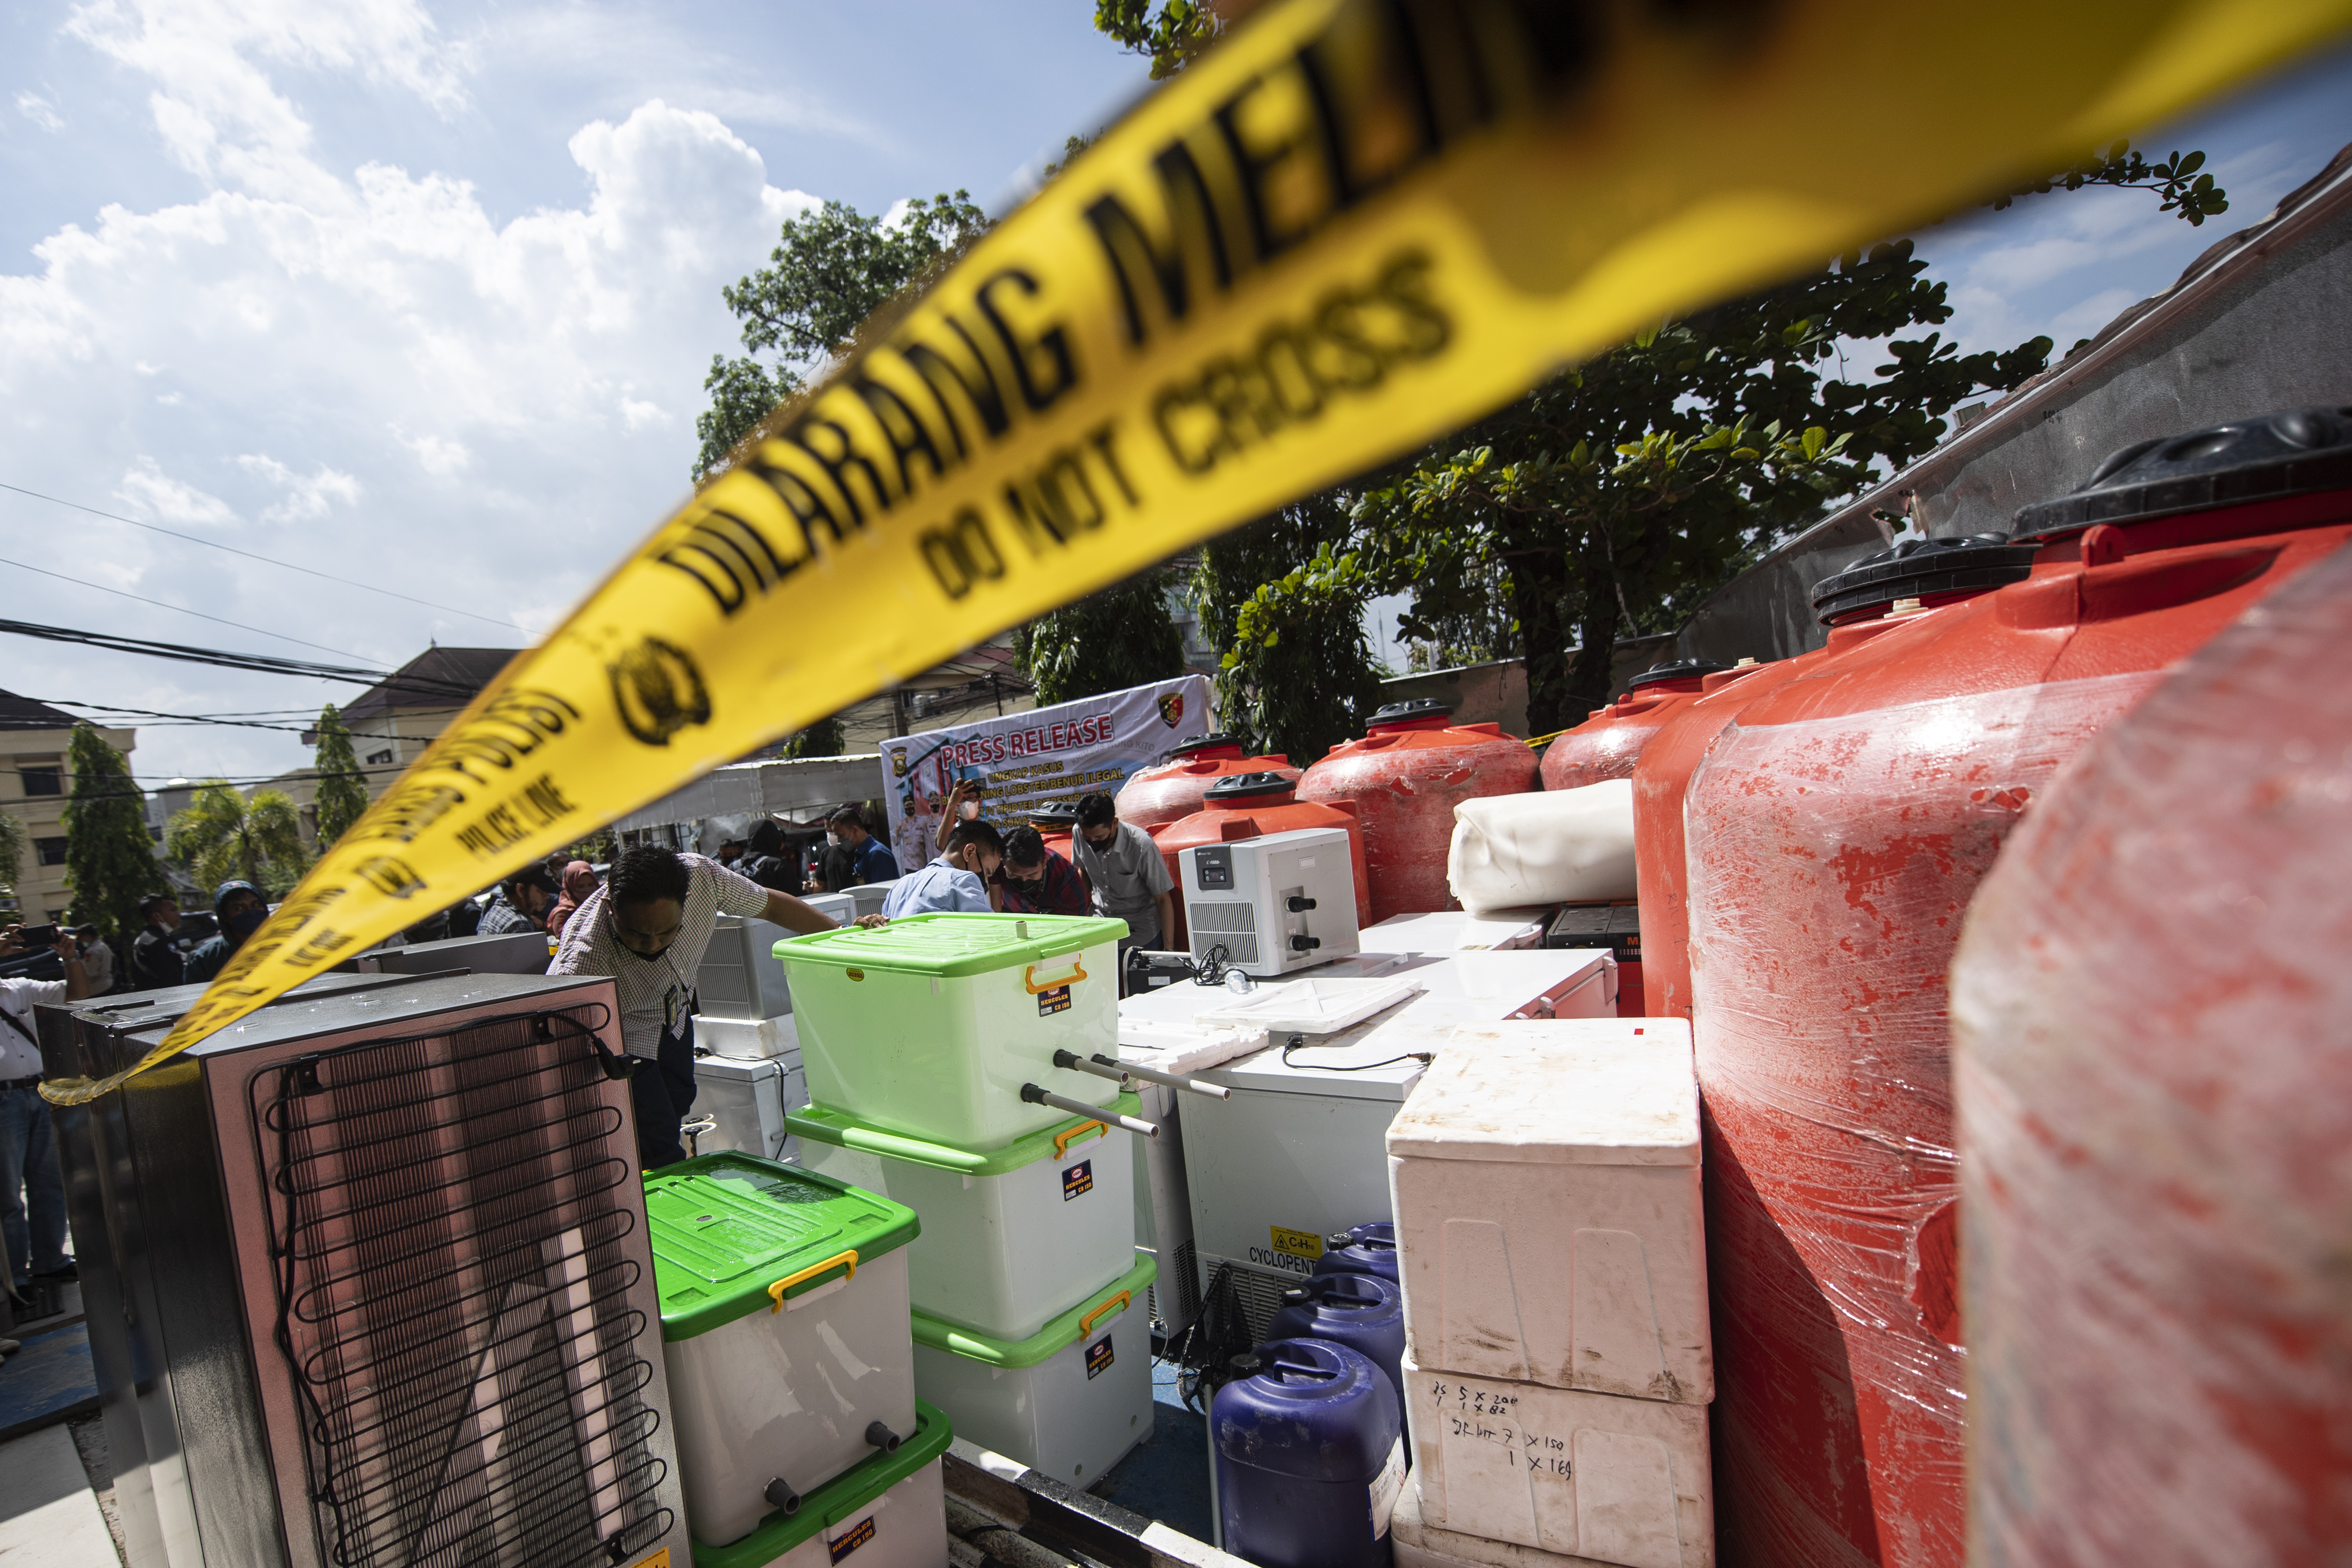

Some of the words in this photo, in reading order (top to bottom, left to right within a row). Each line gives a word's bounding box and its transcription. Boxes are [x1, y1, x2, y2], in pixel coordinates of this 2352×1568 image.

[918, 502, 1008, 602] DO
[1003, 415, 1142, 560] NOT
[1150, 245, 1455, 477] CROSS
[654, 268, 1081, 617] DILARANG
[941, 734, 1005, 770] PRESS
[1010, 714, 1114, 758] RELEASE
[1106, 740, 1133, 749] WONG
[1135, 741, 1155, 751] KITO
[988, 766, 1028, 783] UNGKAP
[1030, 761, 1064, 776] KASUS
[1005, 774, 1084, 795] LOBSTER/BENUR
[1087, 768, 1125, 783] ILEGAL
[986, 806, 994, 816] IV
[995, 800, 1034, 814] TIPIDTER
[1036, 788, 1111, 809] DITRESKRIUS
[1627, 937, 1641, 945] M
[1041, 994, 1068, 1006] HERCULES
[1065, 1175, 1090, 1191] HERCULES
[1289, 1236, 1315, 1251] C5H10
[1250, 1246, 1317, 1275] CYCLOPENT
[1088, 1349, 1111, 1369] HERCULES
[1459, 1386, 1468, 1400] 5
[1502, 1428, 1514, 1443] 7
[1545, 1436, 1563, 1451] 150
[1509, 1450, 1514, 1466] 1
[832, 1520, 871, 1553] HERCULES
[853, 1538, 861, 1548] CB
[862, 1529, 873, 1541] 150
